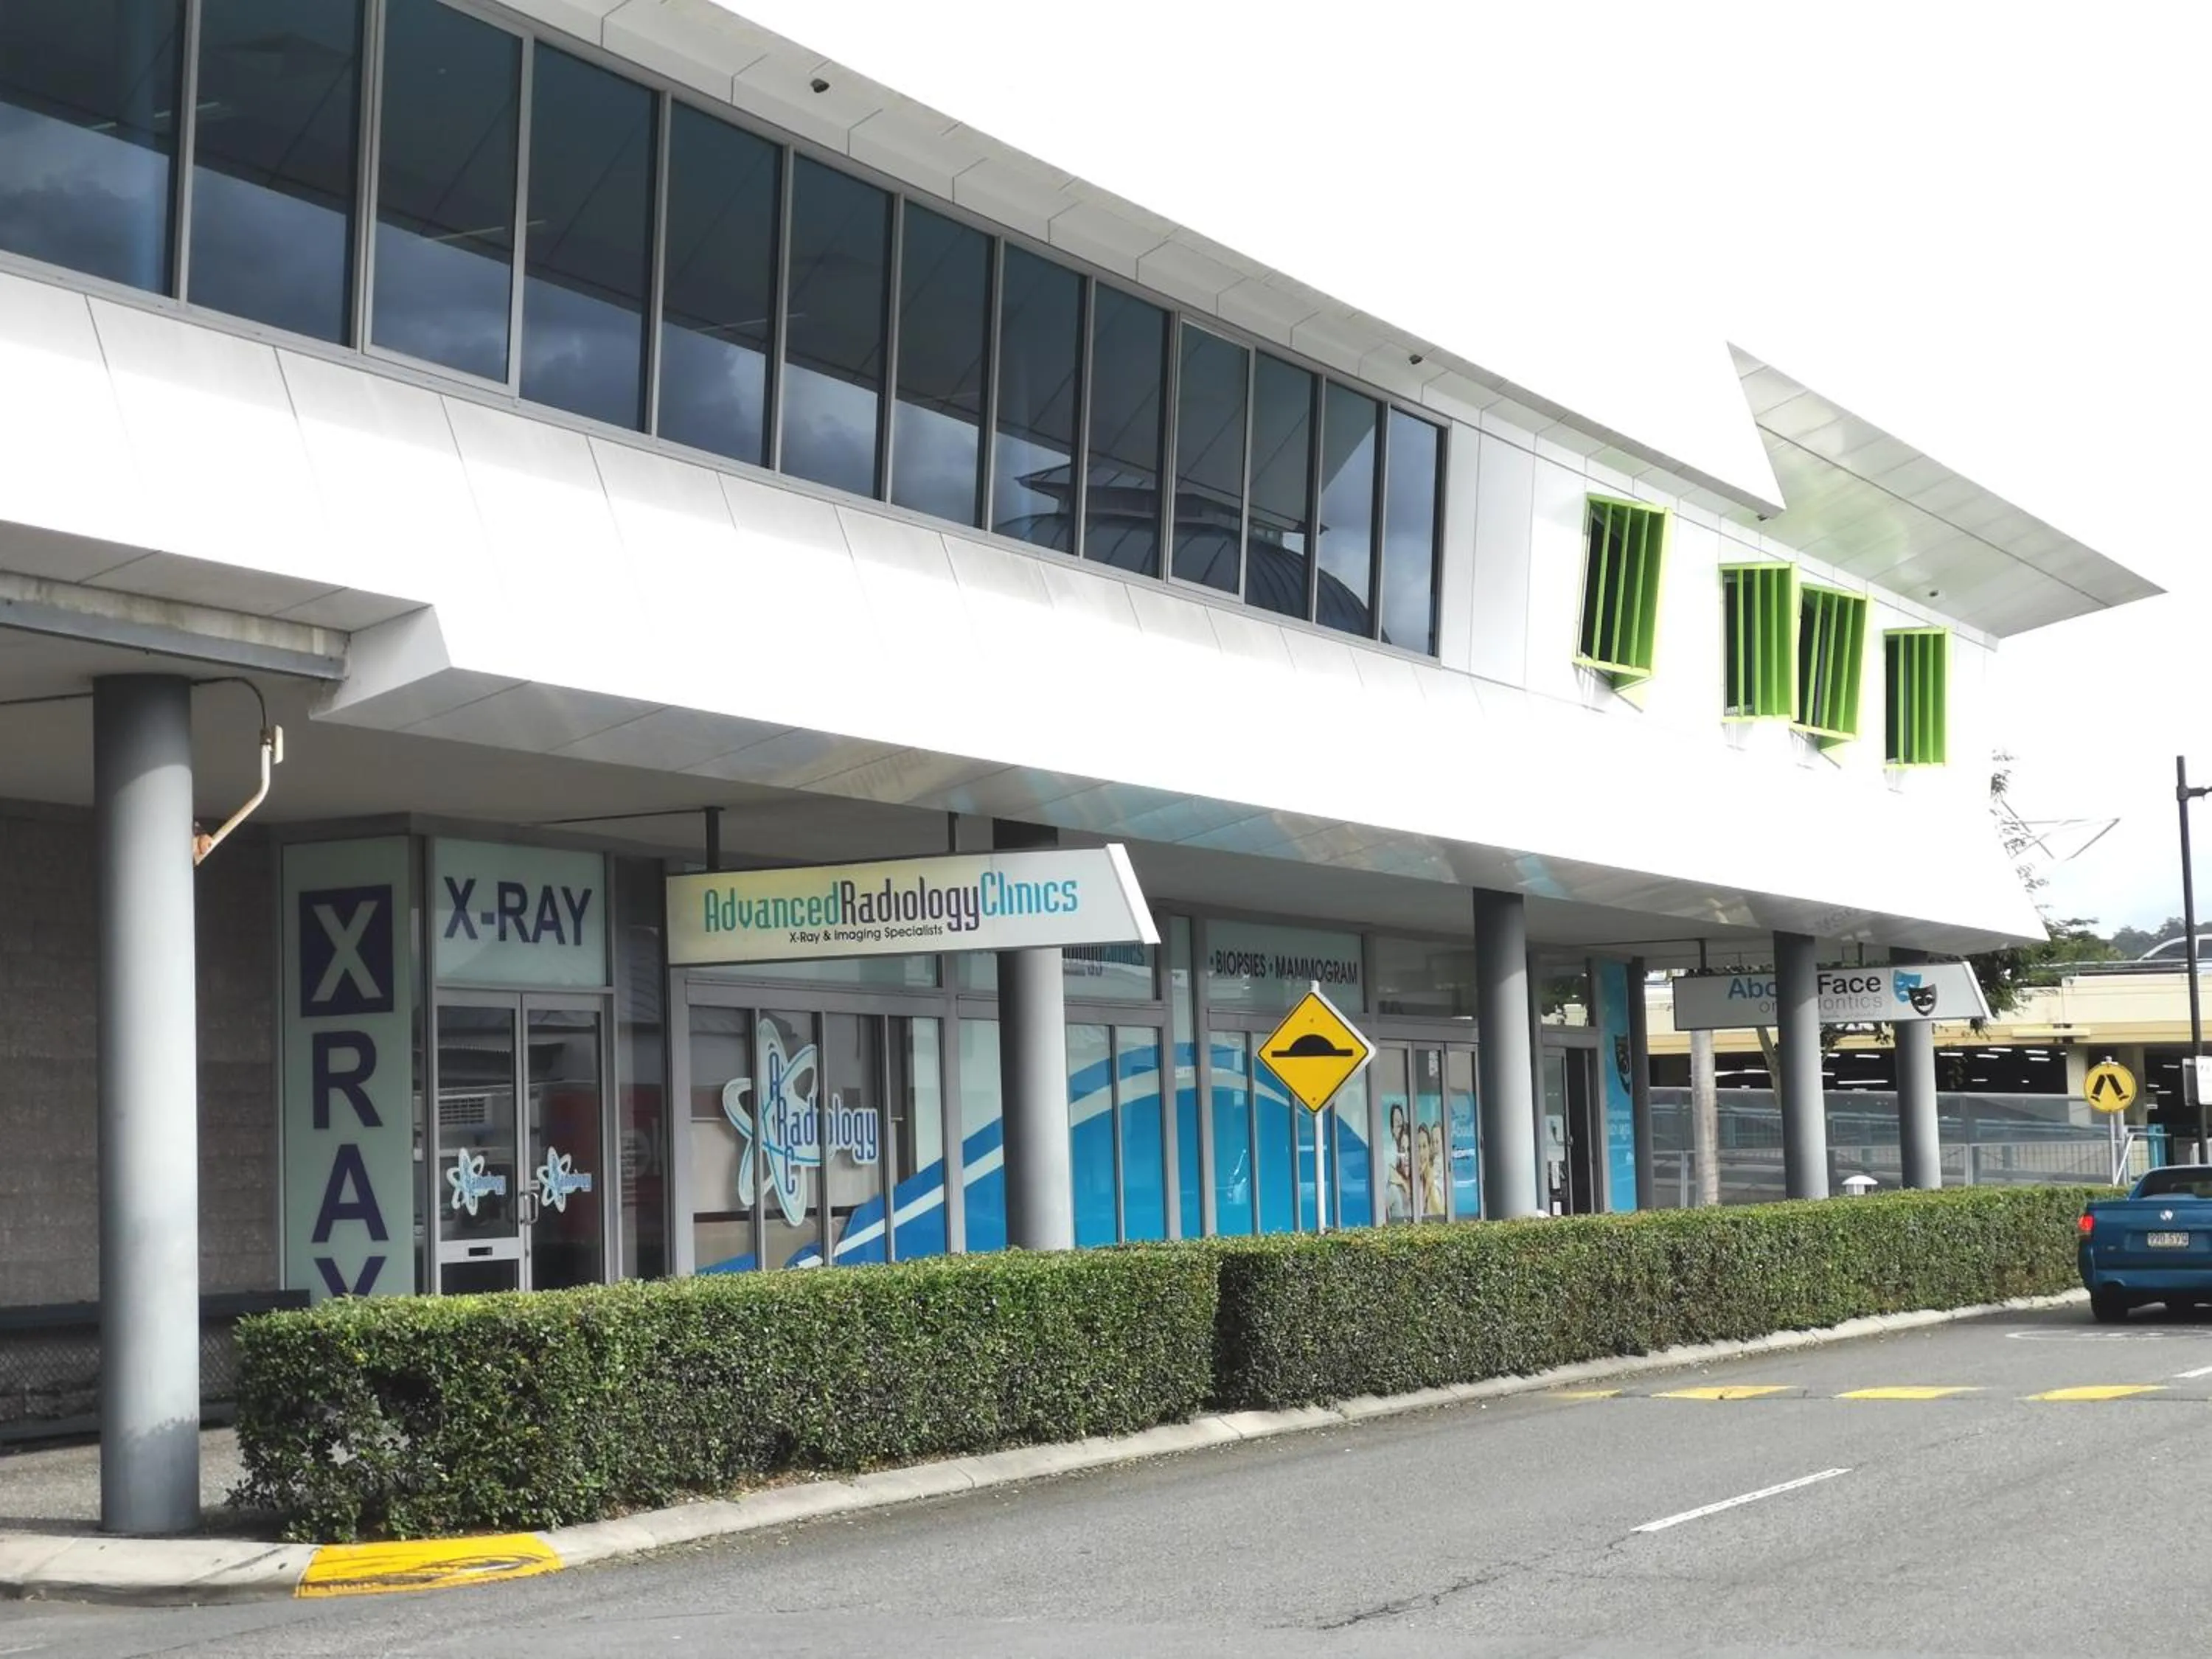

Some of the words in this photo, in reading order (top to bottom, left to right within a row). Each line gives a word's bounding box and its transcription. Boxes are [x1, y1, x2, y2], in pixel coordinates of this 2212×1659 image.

[444, 876, 593, 946] X-RAY
[790, 931, 820, 944] X-Ray
[823, 929, 831, 941] &
[834, 928, 881, 942] Imaging
[884, 924, 943, 939] Specialists
[1216, 950, 1266, 978] BIOPSIES
[1275, 955, 1357, 985] MAMMOGRAM
[1728, 977, 1776, 1000] Abo
[1817, 973, 1881, 995] Face
